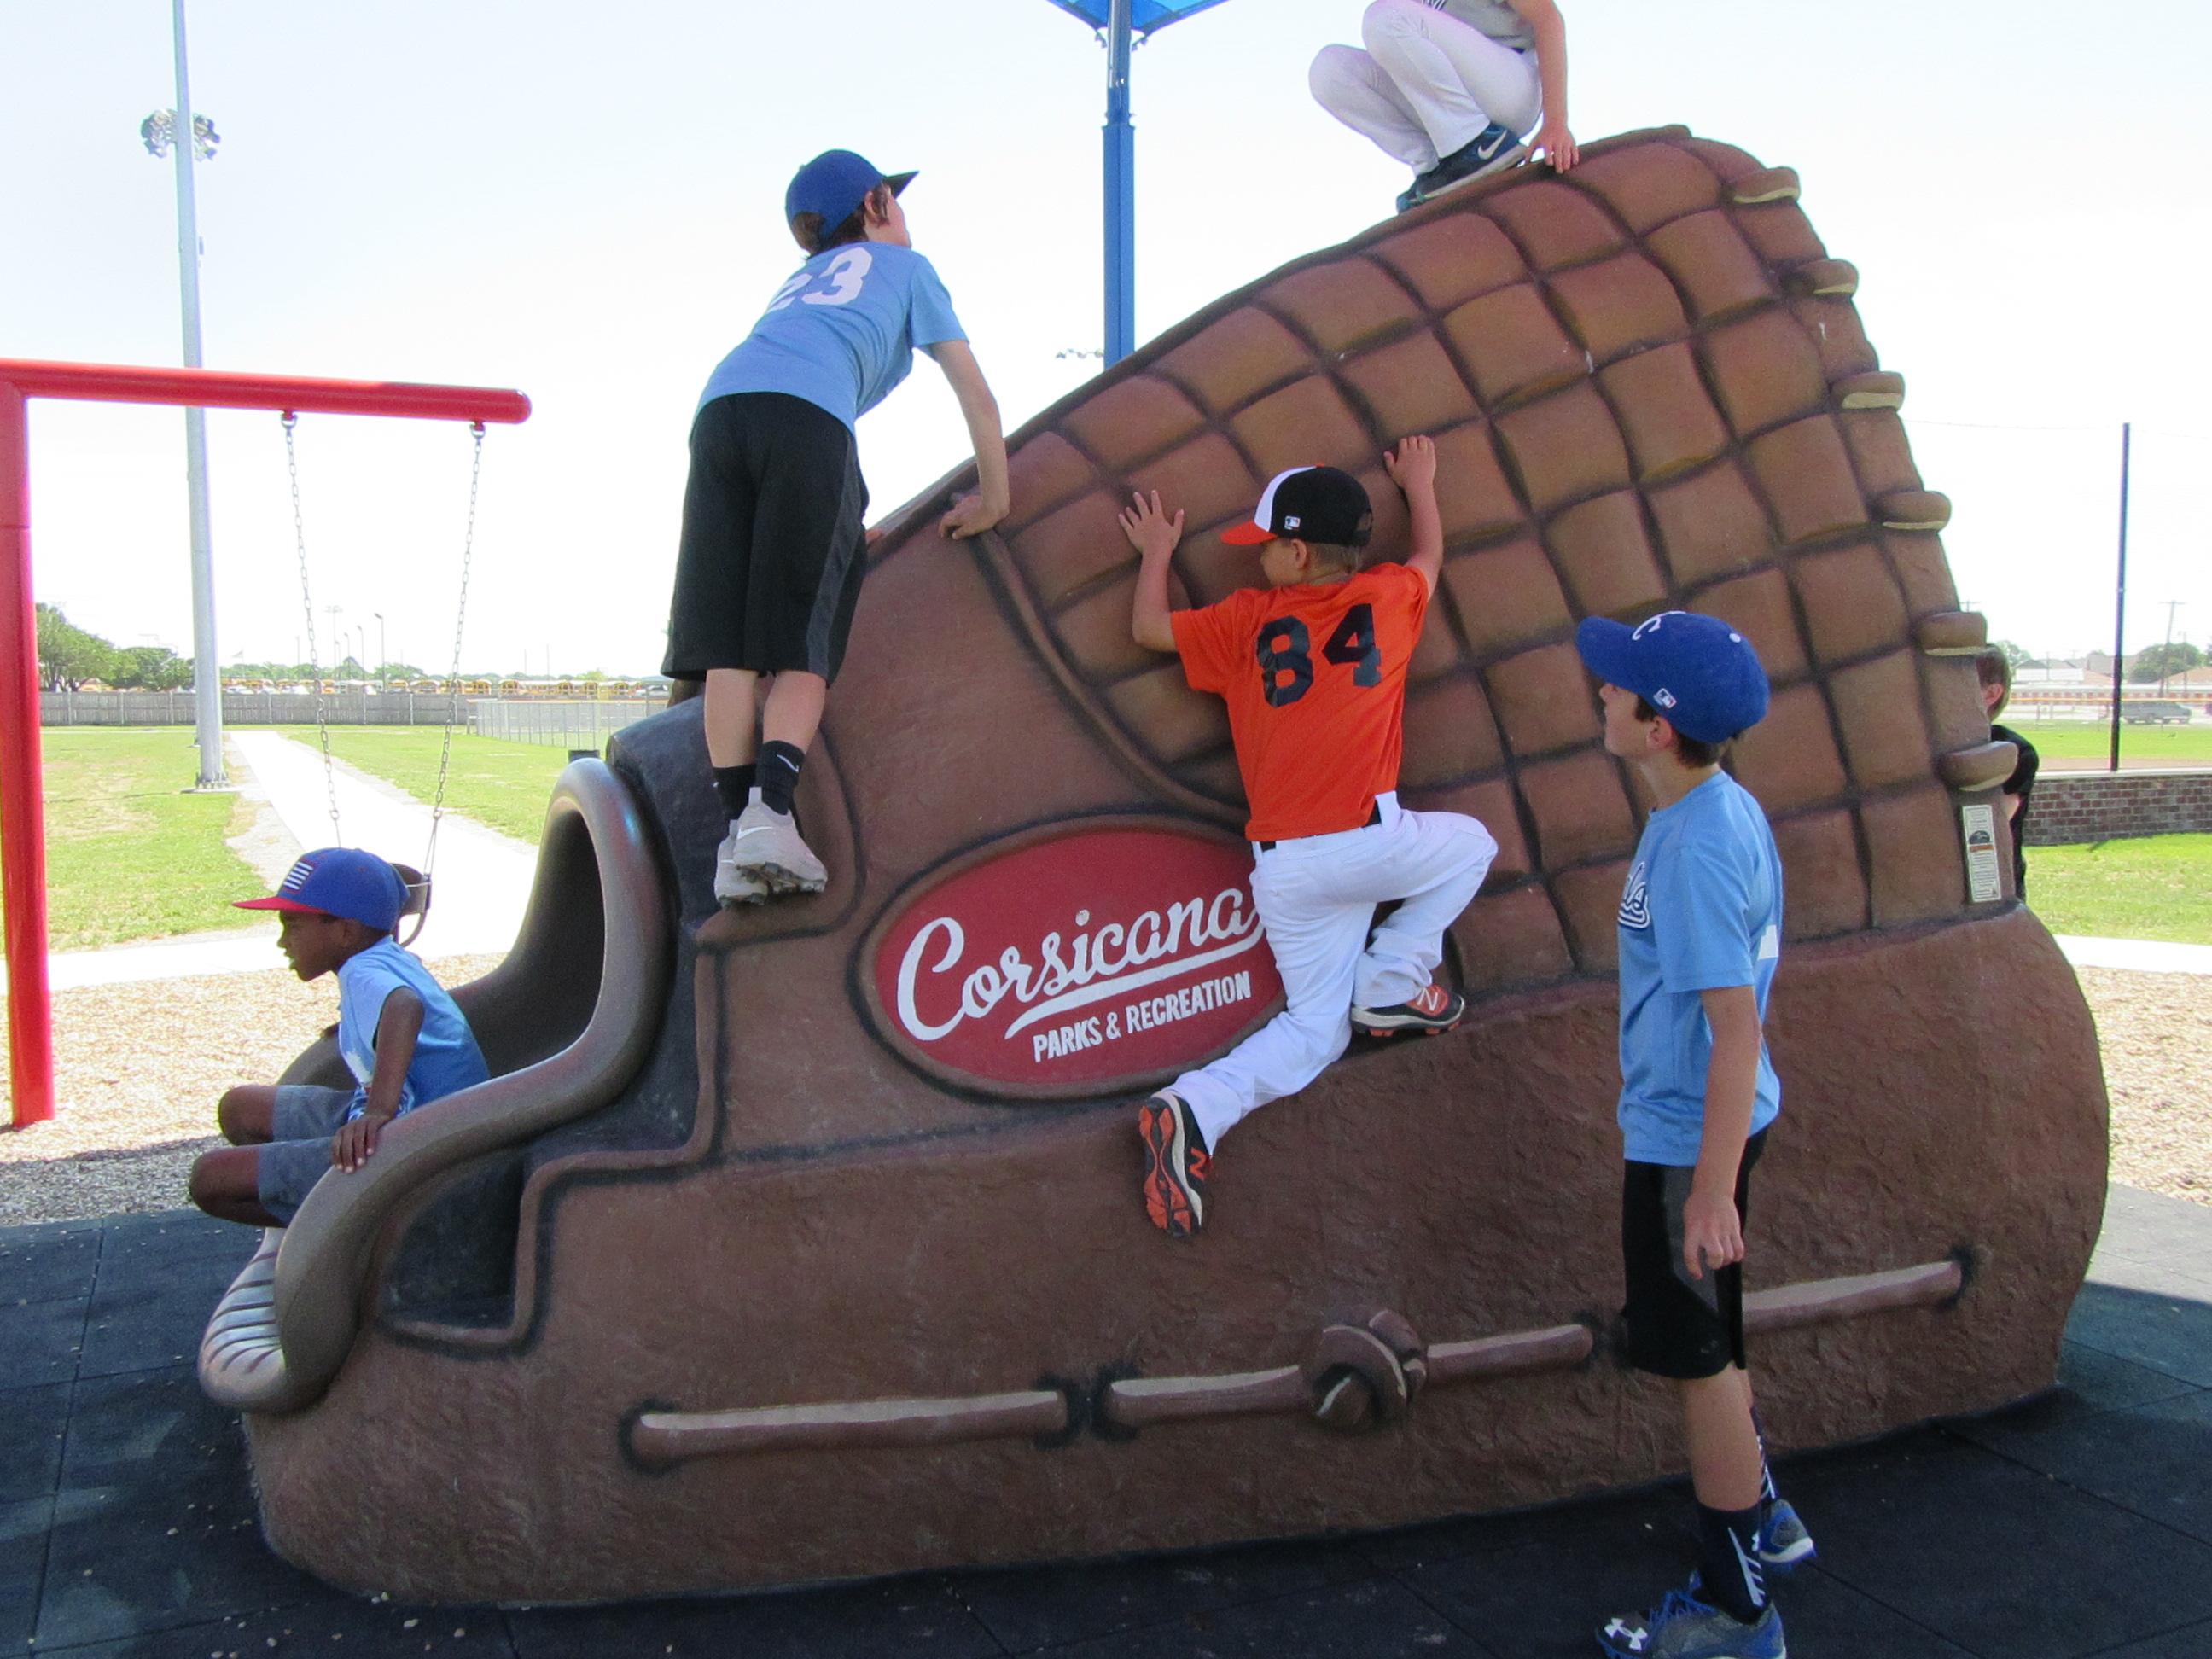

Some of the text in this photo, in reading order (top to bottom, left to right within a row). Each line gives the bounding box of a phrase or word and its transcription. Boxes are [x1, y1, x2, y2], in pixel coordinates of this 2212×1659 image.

[1256, 603, 1382, 708] 84
[897, 888, 1256, 1042] Corsicana
[1033, 970, 1252, 1063] PARKS & RECREATION
